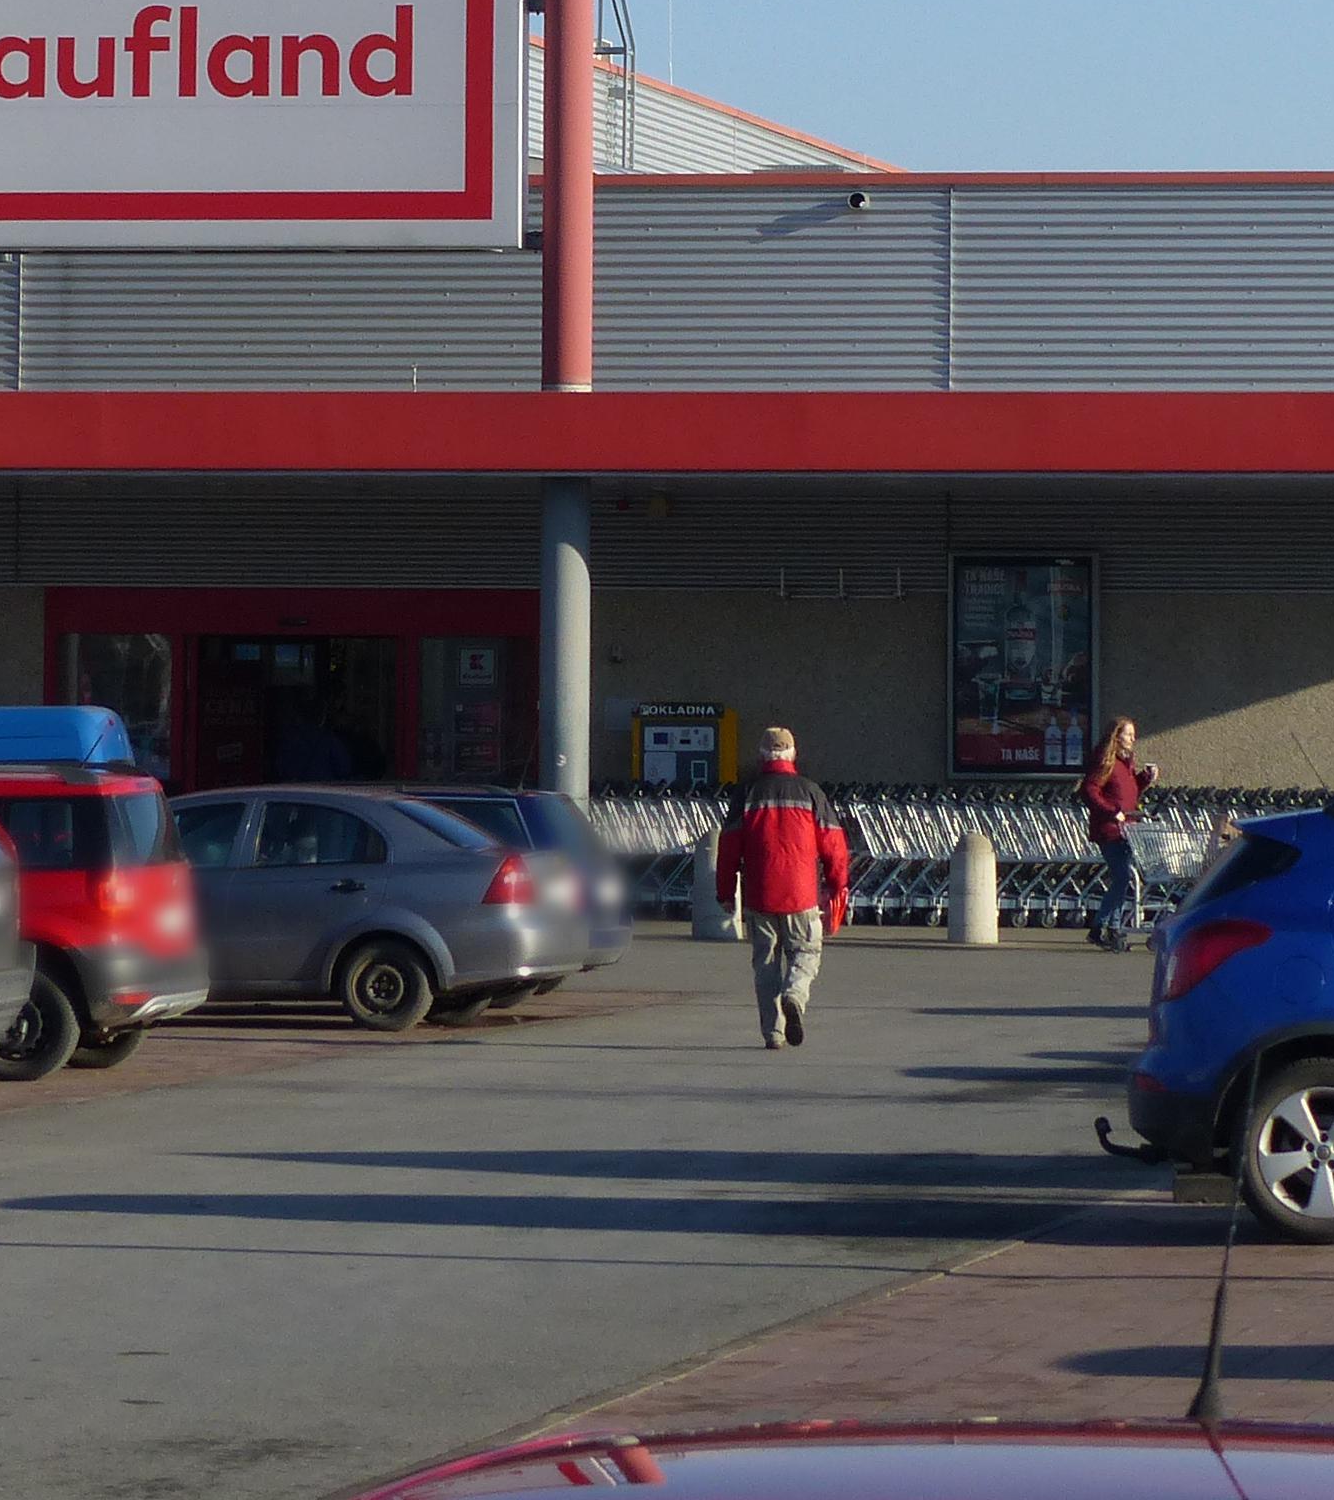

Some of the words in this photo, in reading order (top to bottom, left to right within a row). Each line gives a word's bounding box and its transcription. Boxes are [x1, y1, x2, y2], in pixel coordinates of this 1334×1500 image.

[640, 704, 716, 716] POKLADNA
[1001, 748, 1013, 761] TA
[1014, 746, 1041, 762] NAŠE
